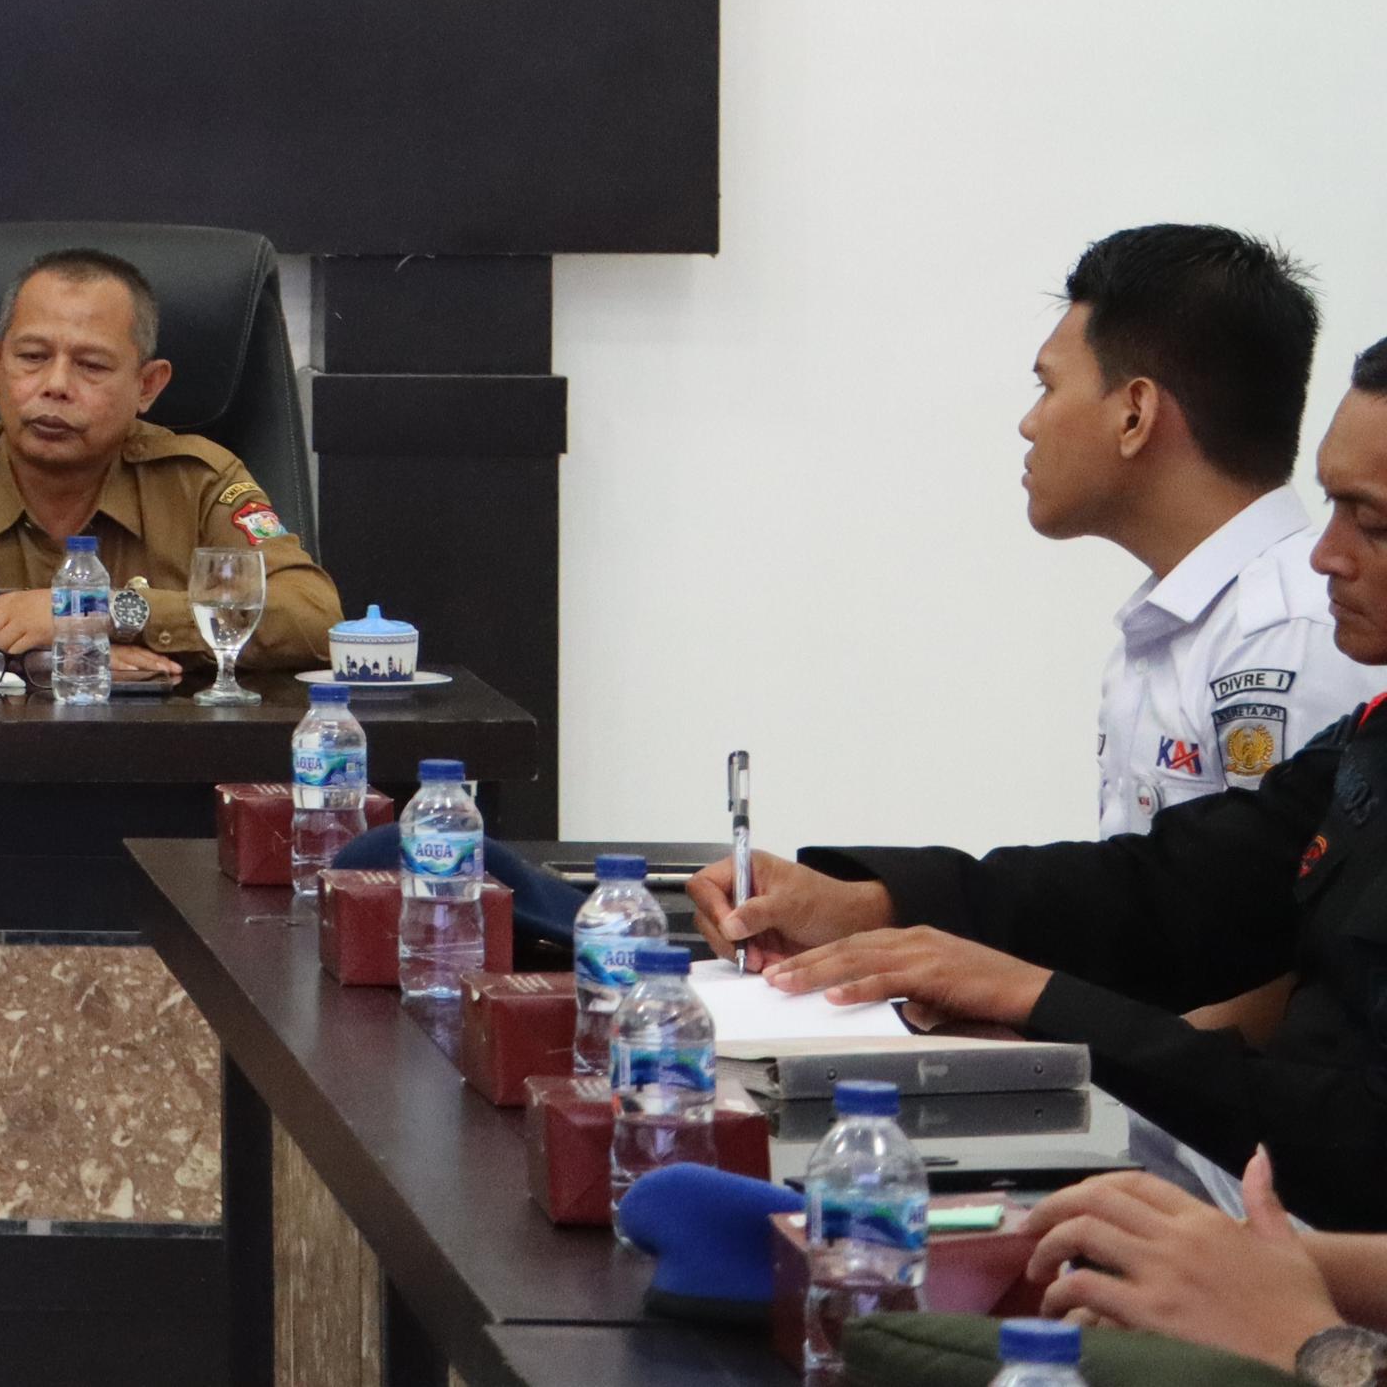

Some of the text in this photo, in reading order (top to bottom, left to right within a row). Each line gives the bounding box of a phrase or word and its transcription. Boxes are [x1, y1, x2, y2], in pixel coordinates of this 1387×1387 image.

[1219, 673, 1284, 695] DIVRE I
[1156, 735, 1202, 775] KAI
[415, 843, 454, 860] AQUA
